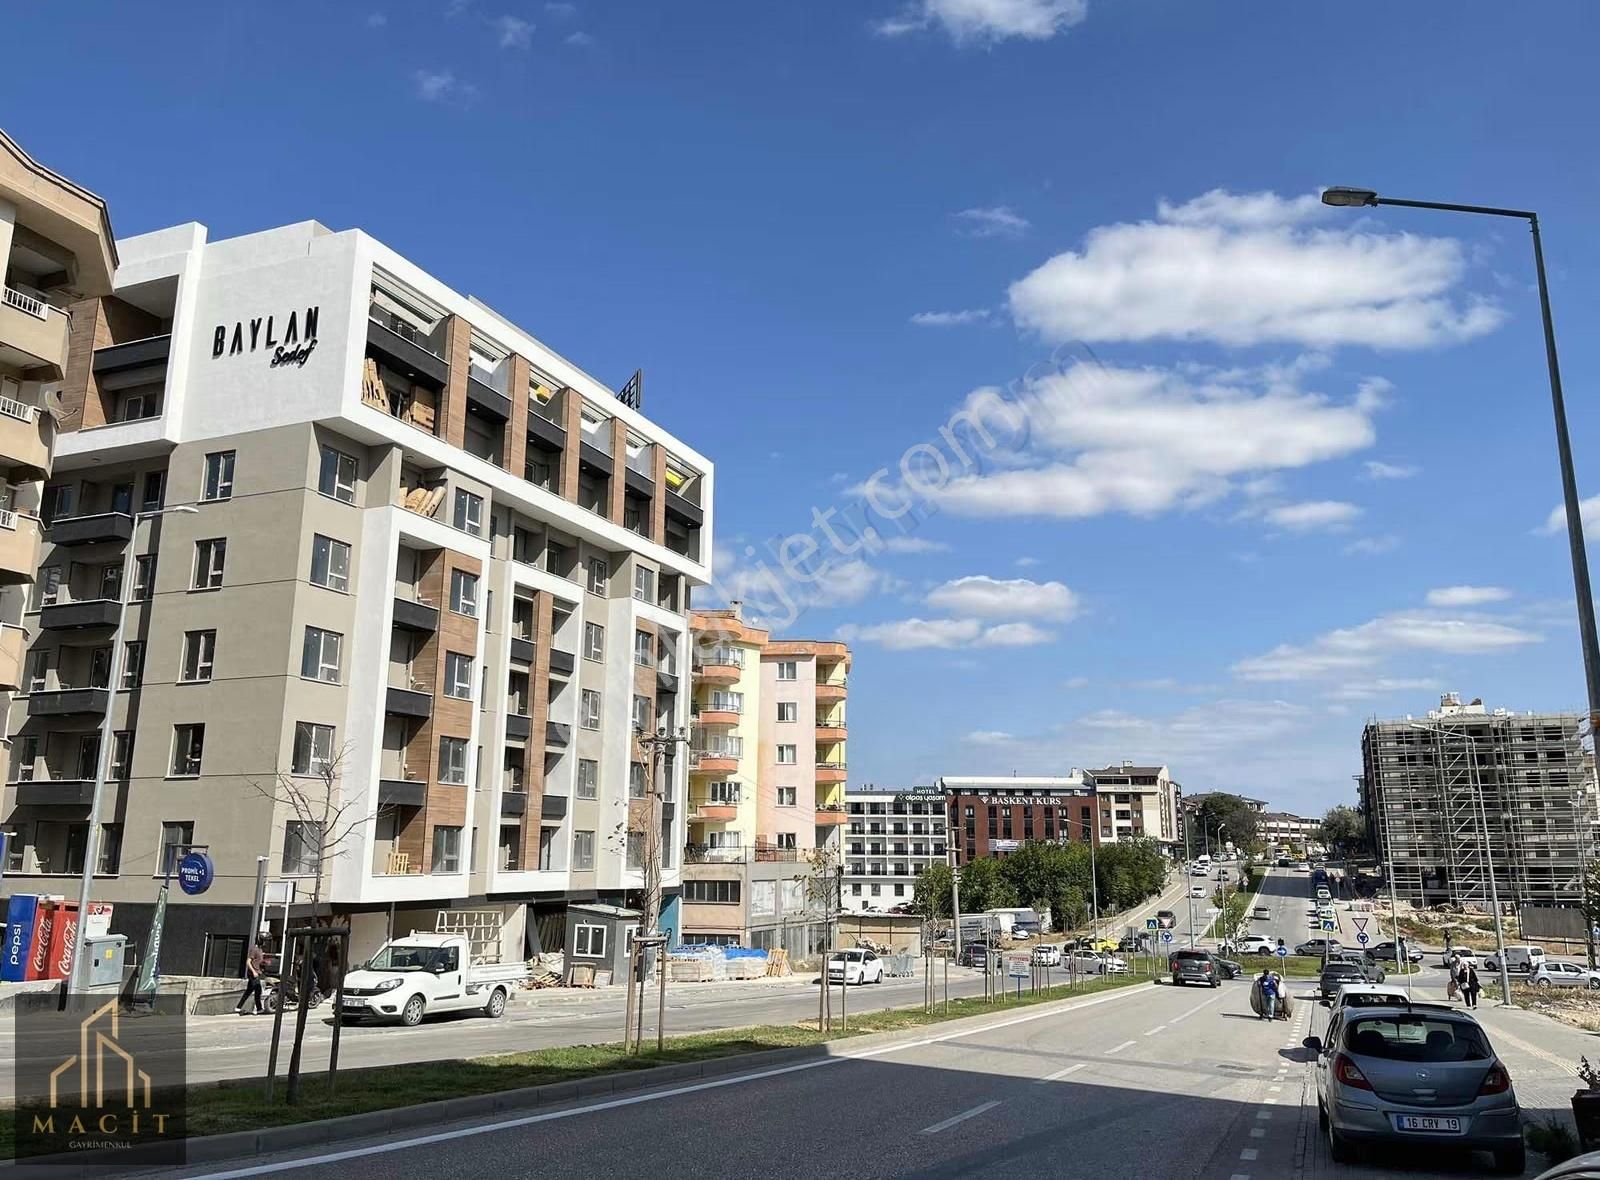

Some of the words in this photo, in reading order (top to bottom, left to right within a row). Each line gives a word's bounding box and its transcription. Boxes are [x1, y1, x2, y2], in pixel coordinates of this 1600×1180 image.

[212, 306, 319, 359] BAYLAN
[270, 338, 318, 368] Sedef
[1036, 797, 1062, 806] KURS
[185, 874, 200, 882] TEKEL
[10, 924, 22, 966] pepsi
[1407, 1117, 1418, 1128] 16
[1446, 1119, 1458, 1130] 19
